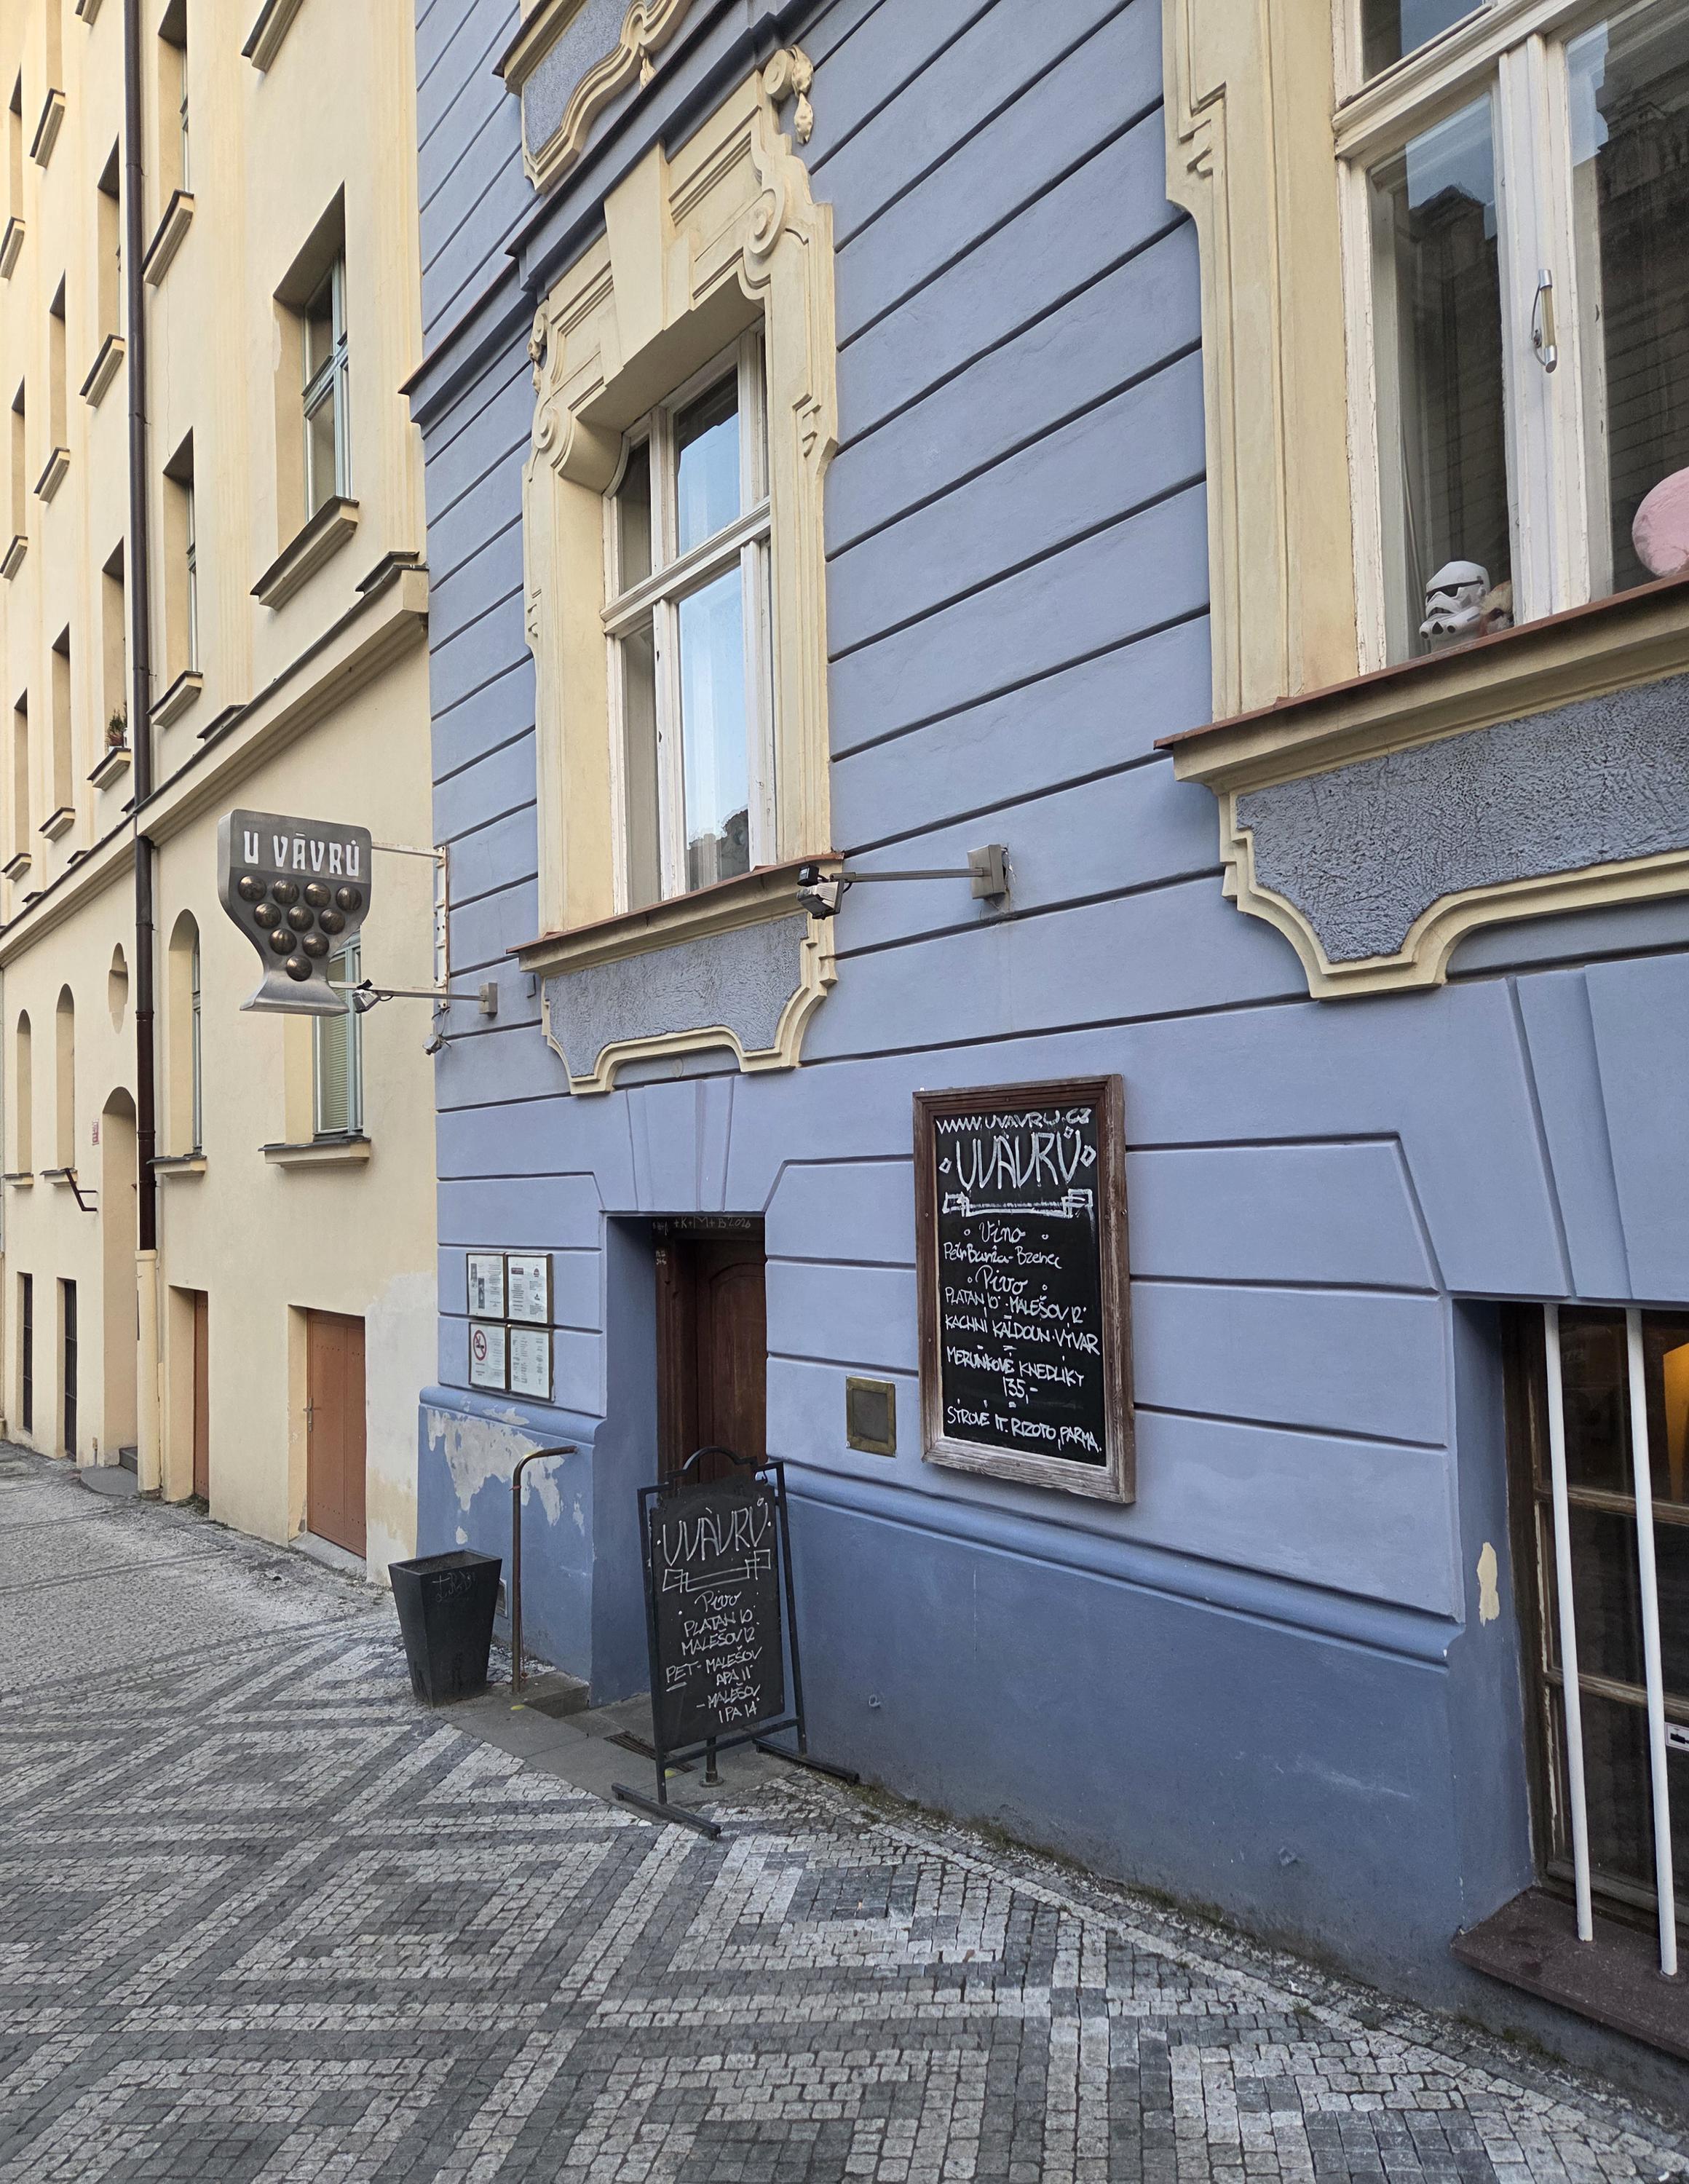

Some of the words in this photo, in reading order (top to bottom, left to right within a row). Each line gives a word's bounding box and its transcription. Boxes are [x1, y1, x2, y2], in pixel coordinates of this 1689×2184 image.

[244, 831, 258, 865] U
[979, 1219, 1026, 1243] Víno
[975, 1265, 1029, 1295] Pivo
[946, 1286, 985, 1305] PLATAN
[946, 1306, 988, 1333] KACHNÍ
[1054, 1322, 1101, 1356] VÝVAR
[1019, 1355, 1085, 1387] KNEDLÍKY
[947, 1398, 990, 1427] SÝROVÉ
[994, 1414, 1008, 1433] IT.
[694, 1590, 742, 1613] Pivo
[684, 1612, 736, 1637] PLATAN
[681, 1628, 743, 1655] MALEŠOV
[705, 1645, 762, 1674] MALEŠOV
[716, 1669, 739, 1686] APA
